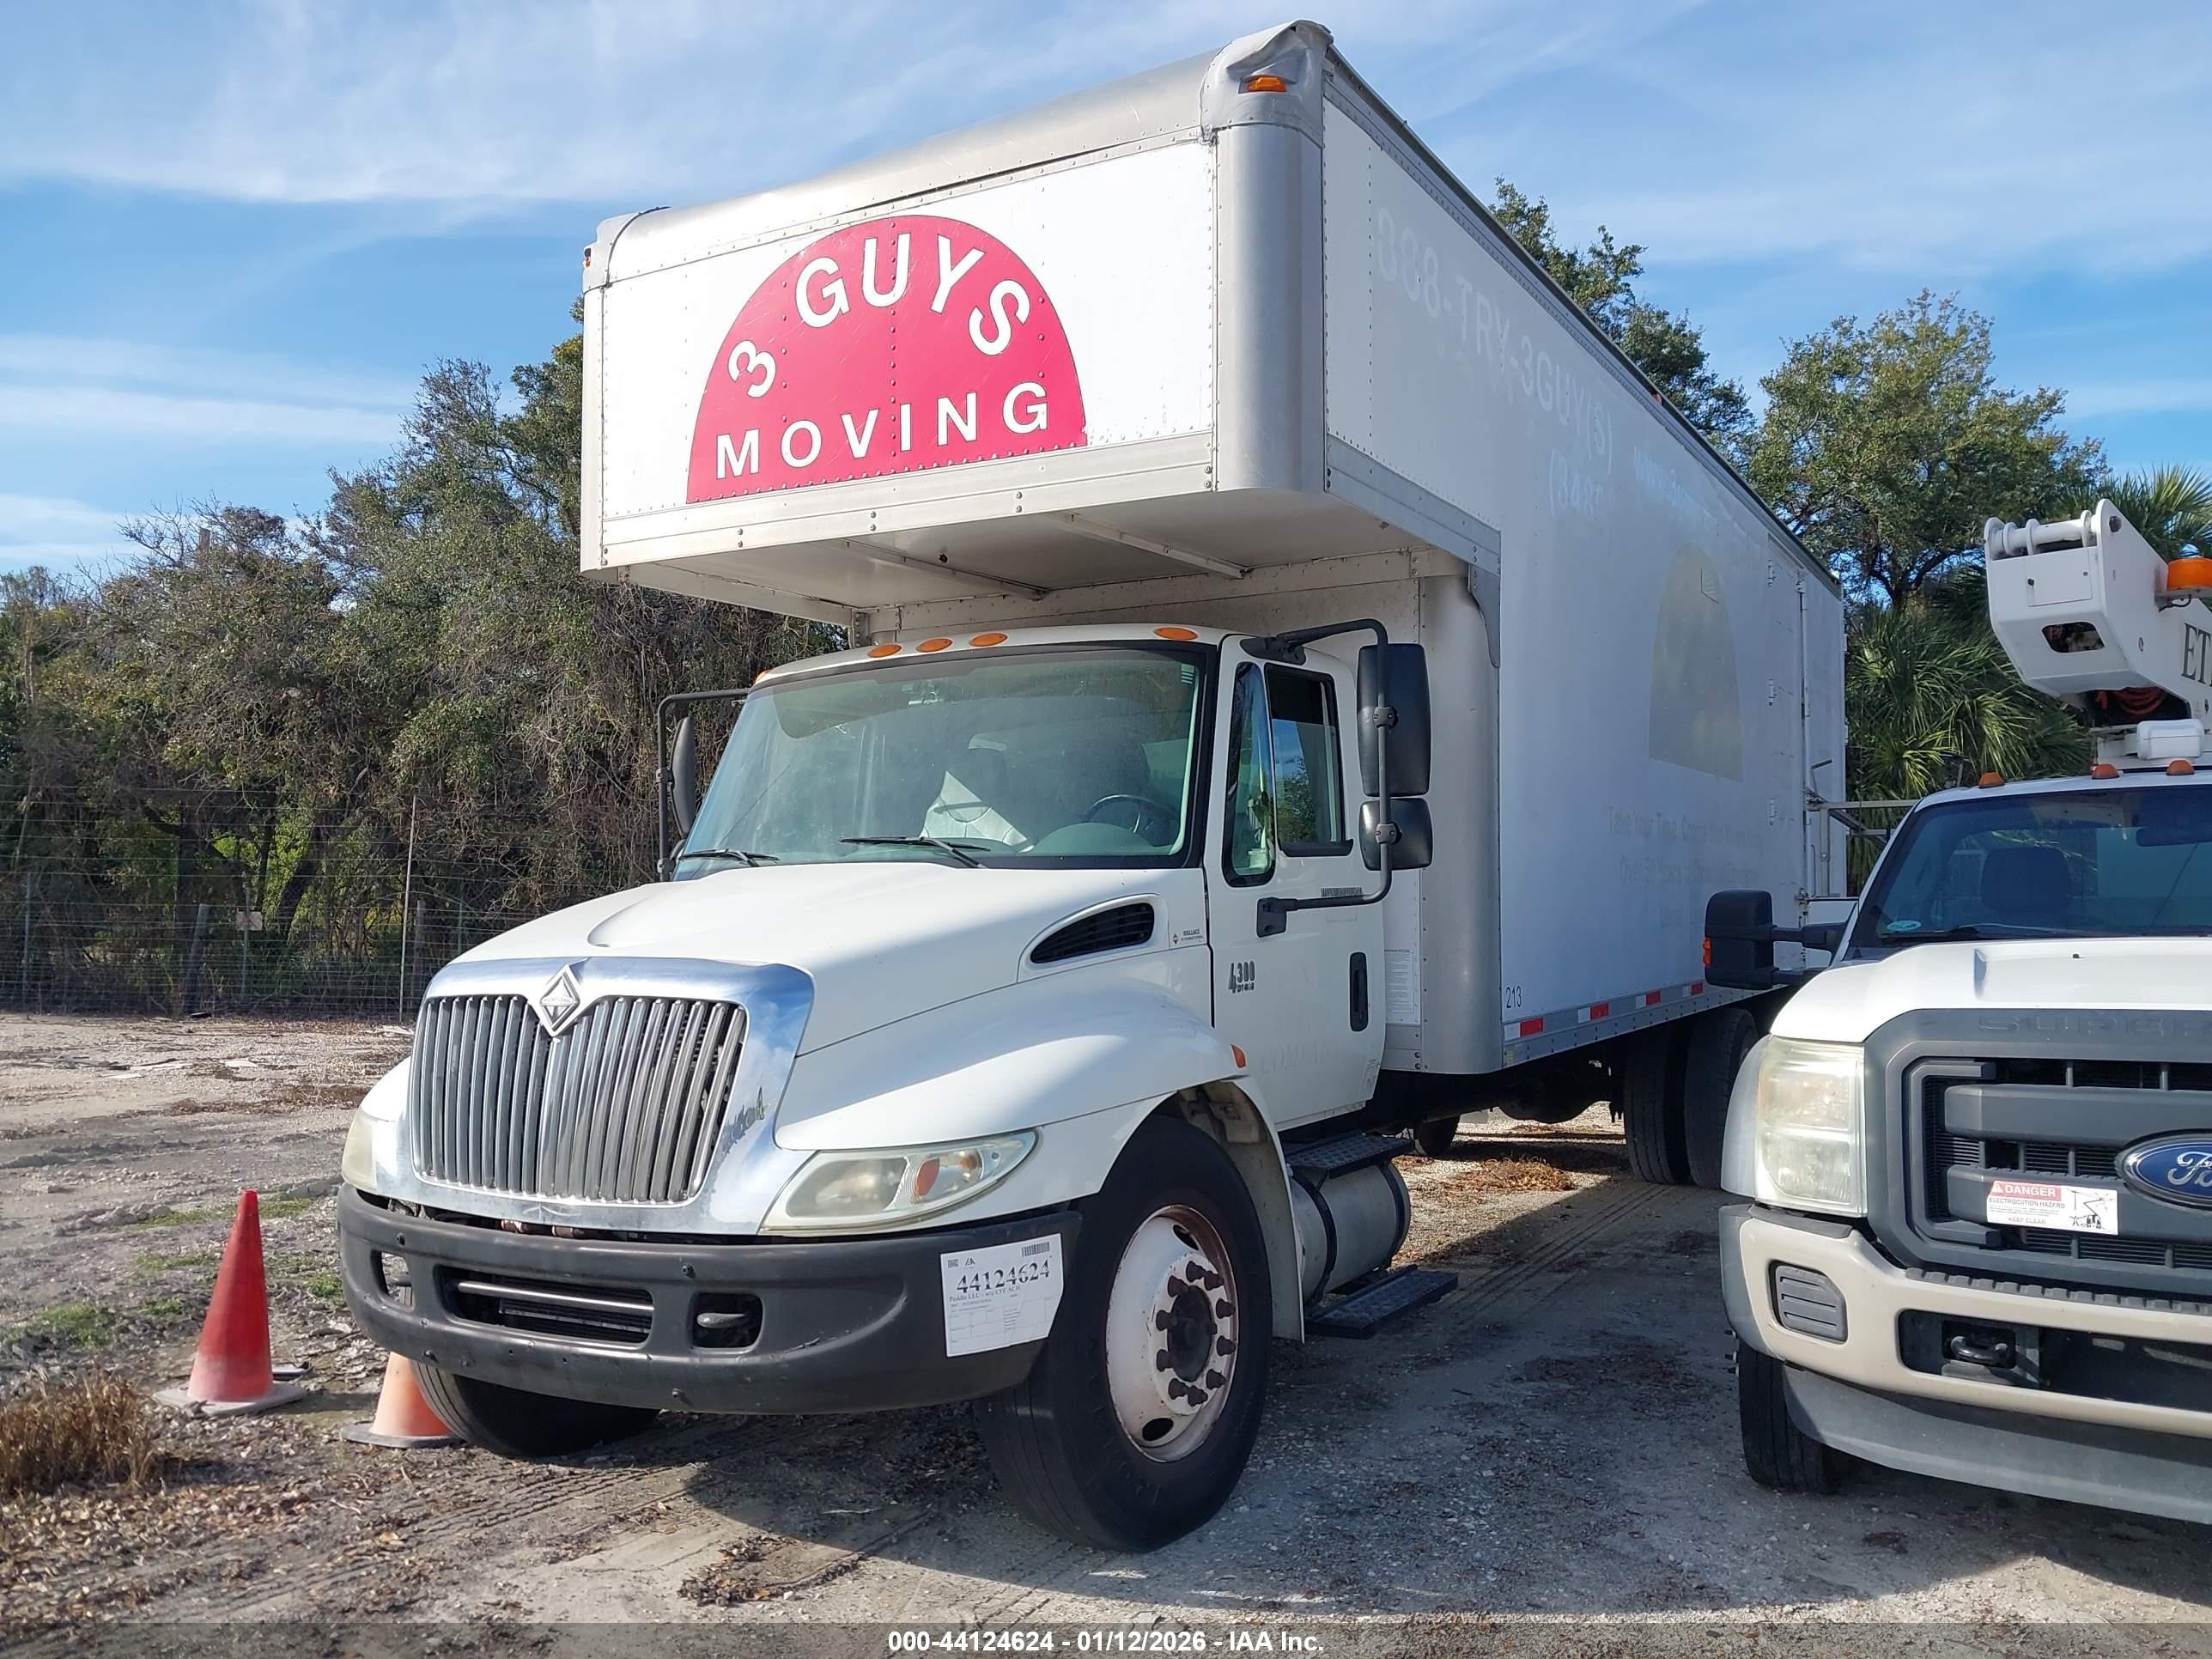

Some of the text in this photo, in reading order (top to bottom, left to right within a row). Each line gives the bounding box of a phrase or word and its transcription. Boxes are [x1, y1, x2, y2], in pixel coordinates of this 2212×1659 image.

[726, 232, 1031, 399] 3 GUYS
[715, 380, 1049, 481] MOVING
[1228, 960, 1255, 994] 4300
[1505, 985, 1522, 1009] 213
[1989, 1197, 2039, 1206] ELECTROCUTION
[2005, 1185, 2057, 1197] DANGER
[956, 1258, 1050, 1294] 44124624
